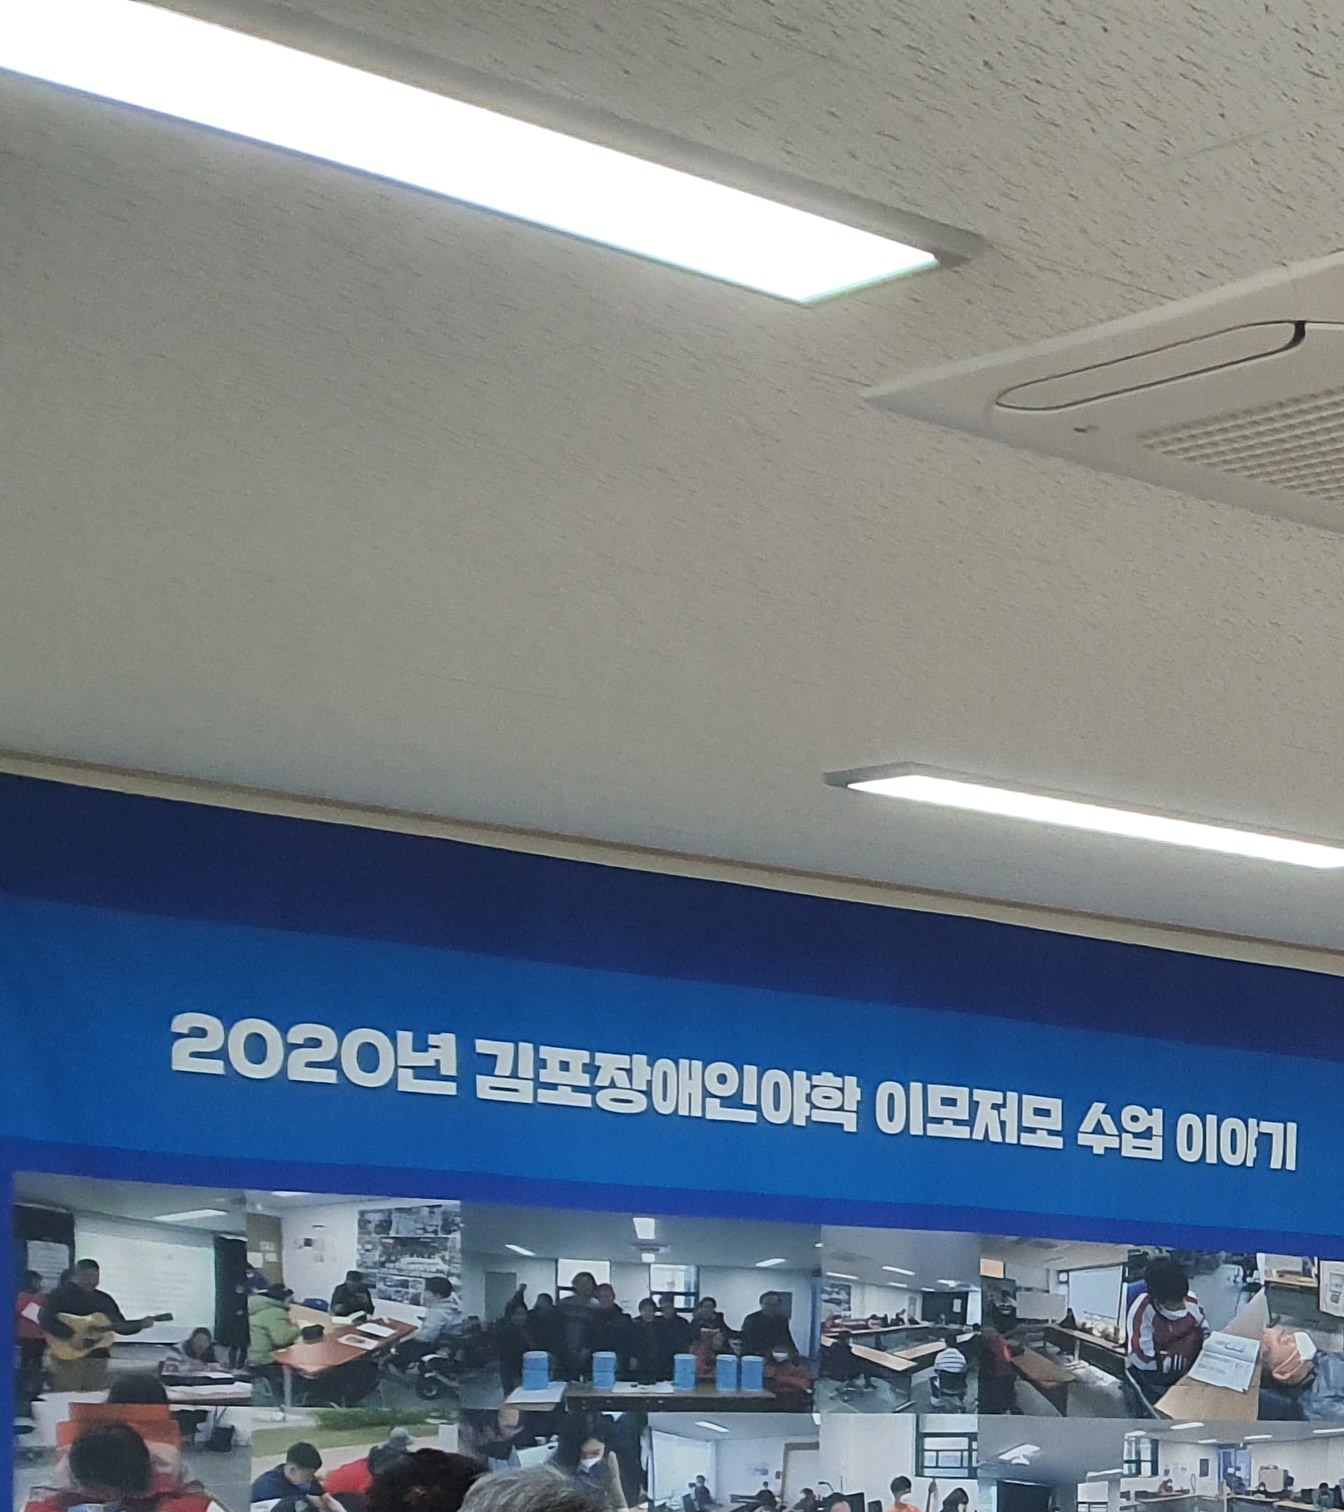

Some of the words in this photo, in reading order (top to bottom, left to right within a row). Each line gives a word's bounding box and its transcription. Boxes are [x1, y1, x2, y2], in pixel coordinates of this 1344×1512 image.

[171, 1012, 457, 1096] 2020년
[475, 1039, 861, 1133] 김포장애인야학
[875, 1081, 1064, 1149] 이모저모
[1077, 1102, 1163, 1161] 수업
[1176, 1113, 1297, 1171] 이야기
